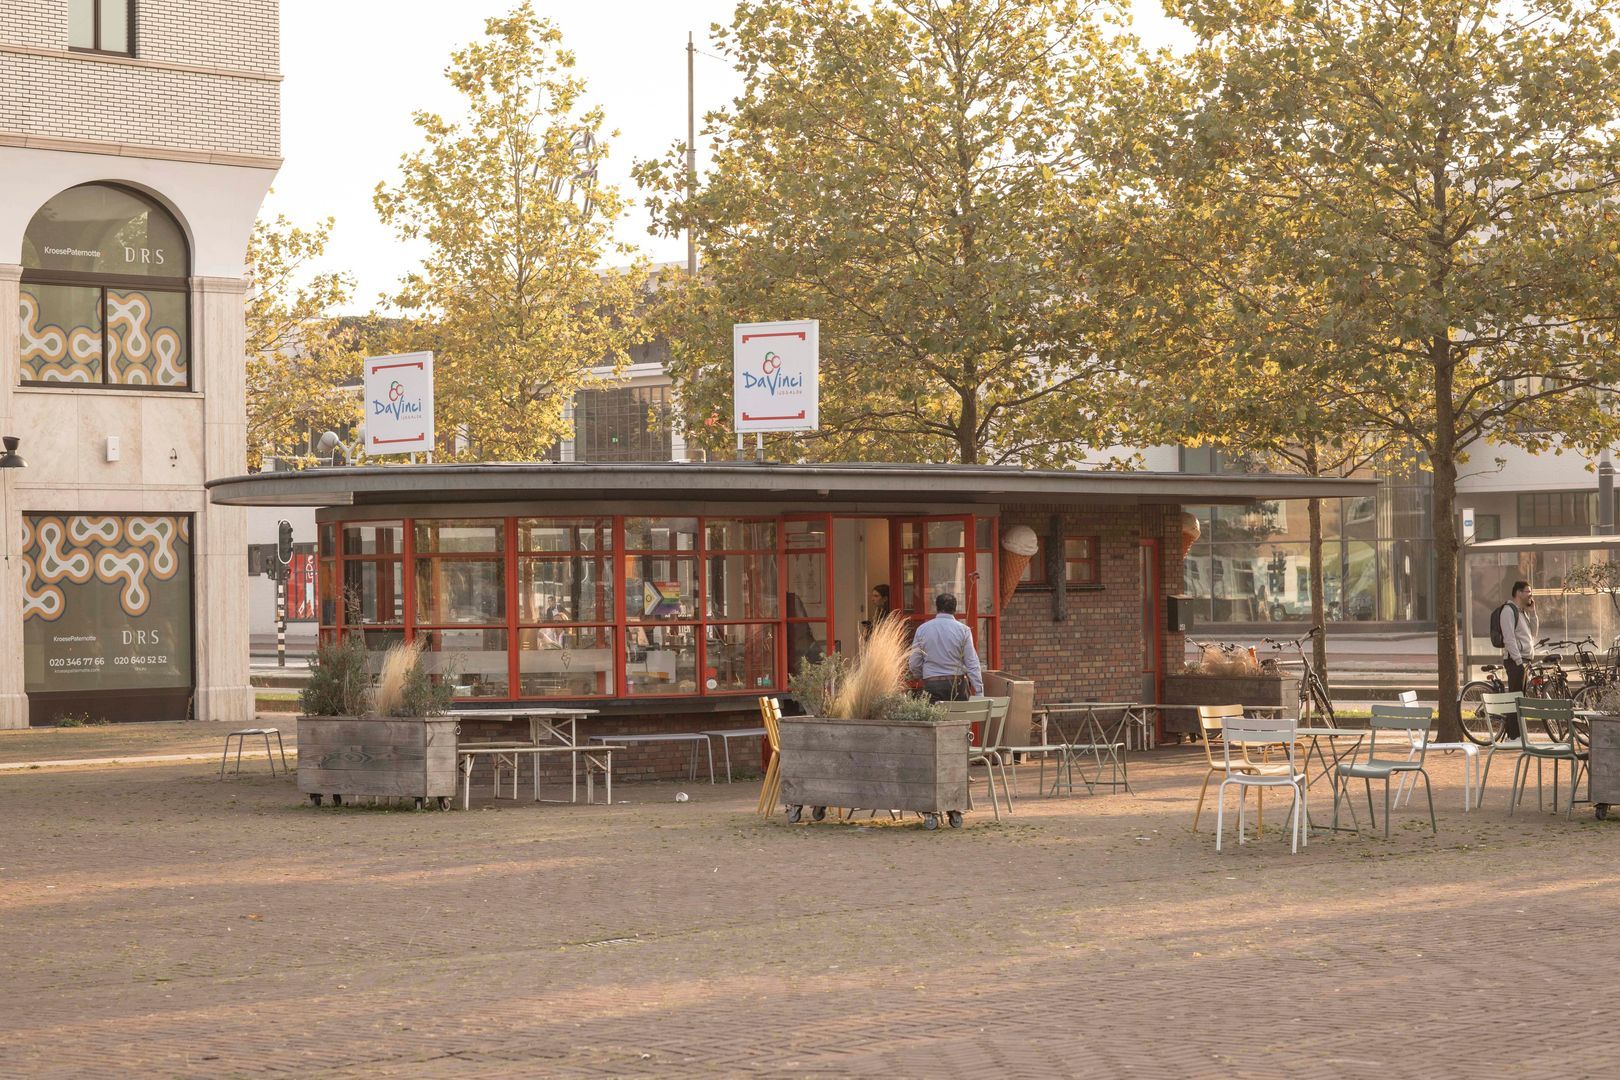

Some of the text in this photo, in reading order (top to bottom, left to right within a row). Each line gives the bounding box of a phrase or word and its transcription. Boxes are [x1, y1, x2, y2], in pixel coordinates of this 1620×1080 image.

[49, 657, 105, 667] 020 346 77 66
[114, 655, 167, 665] 020 640 52 52
